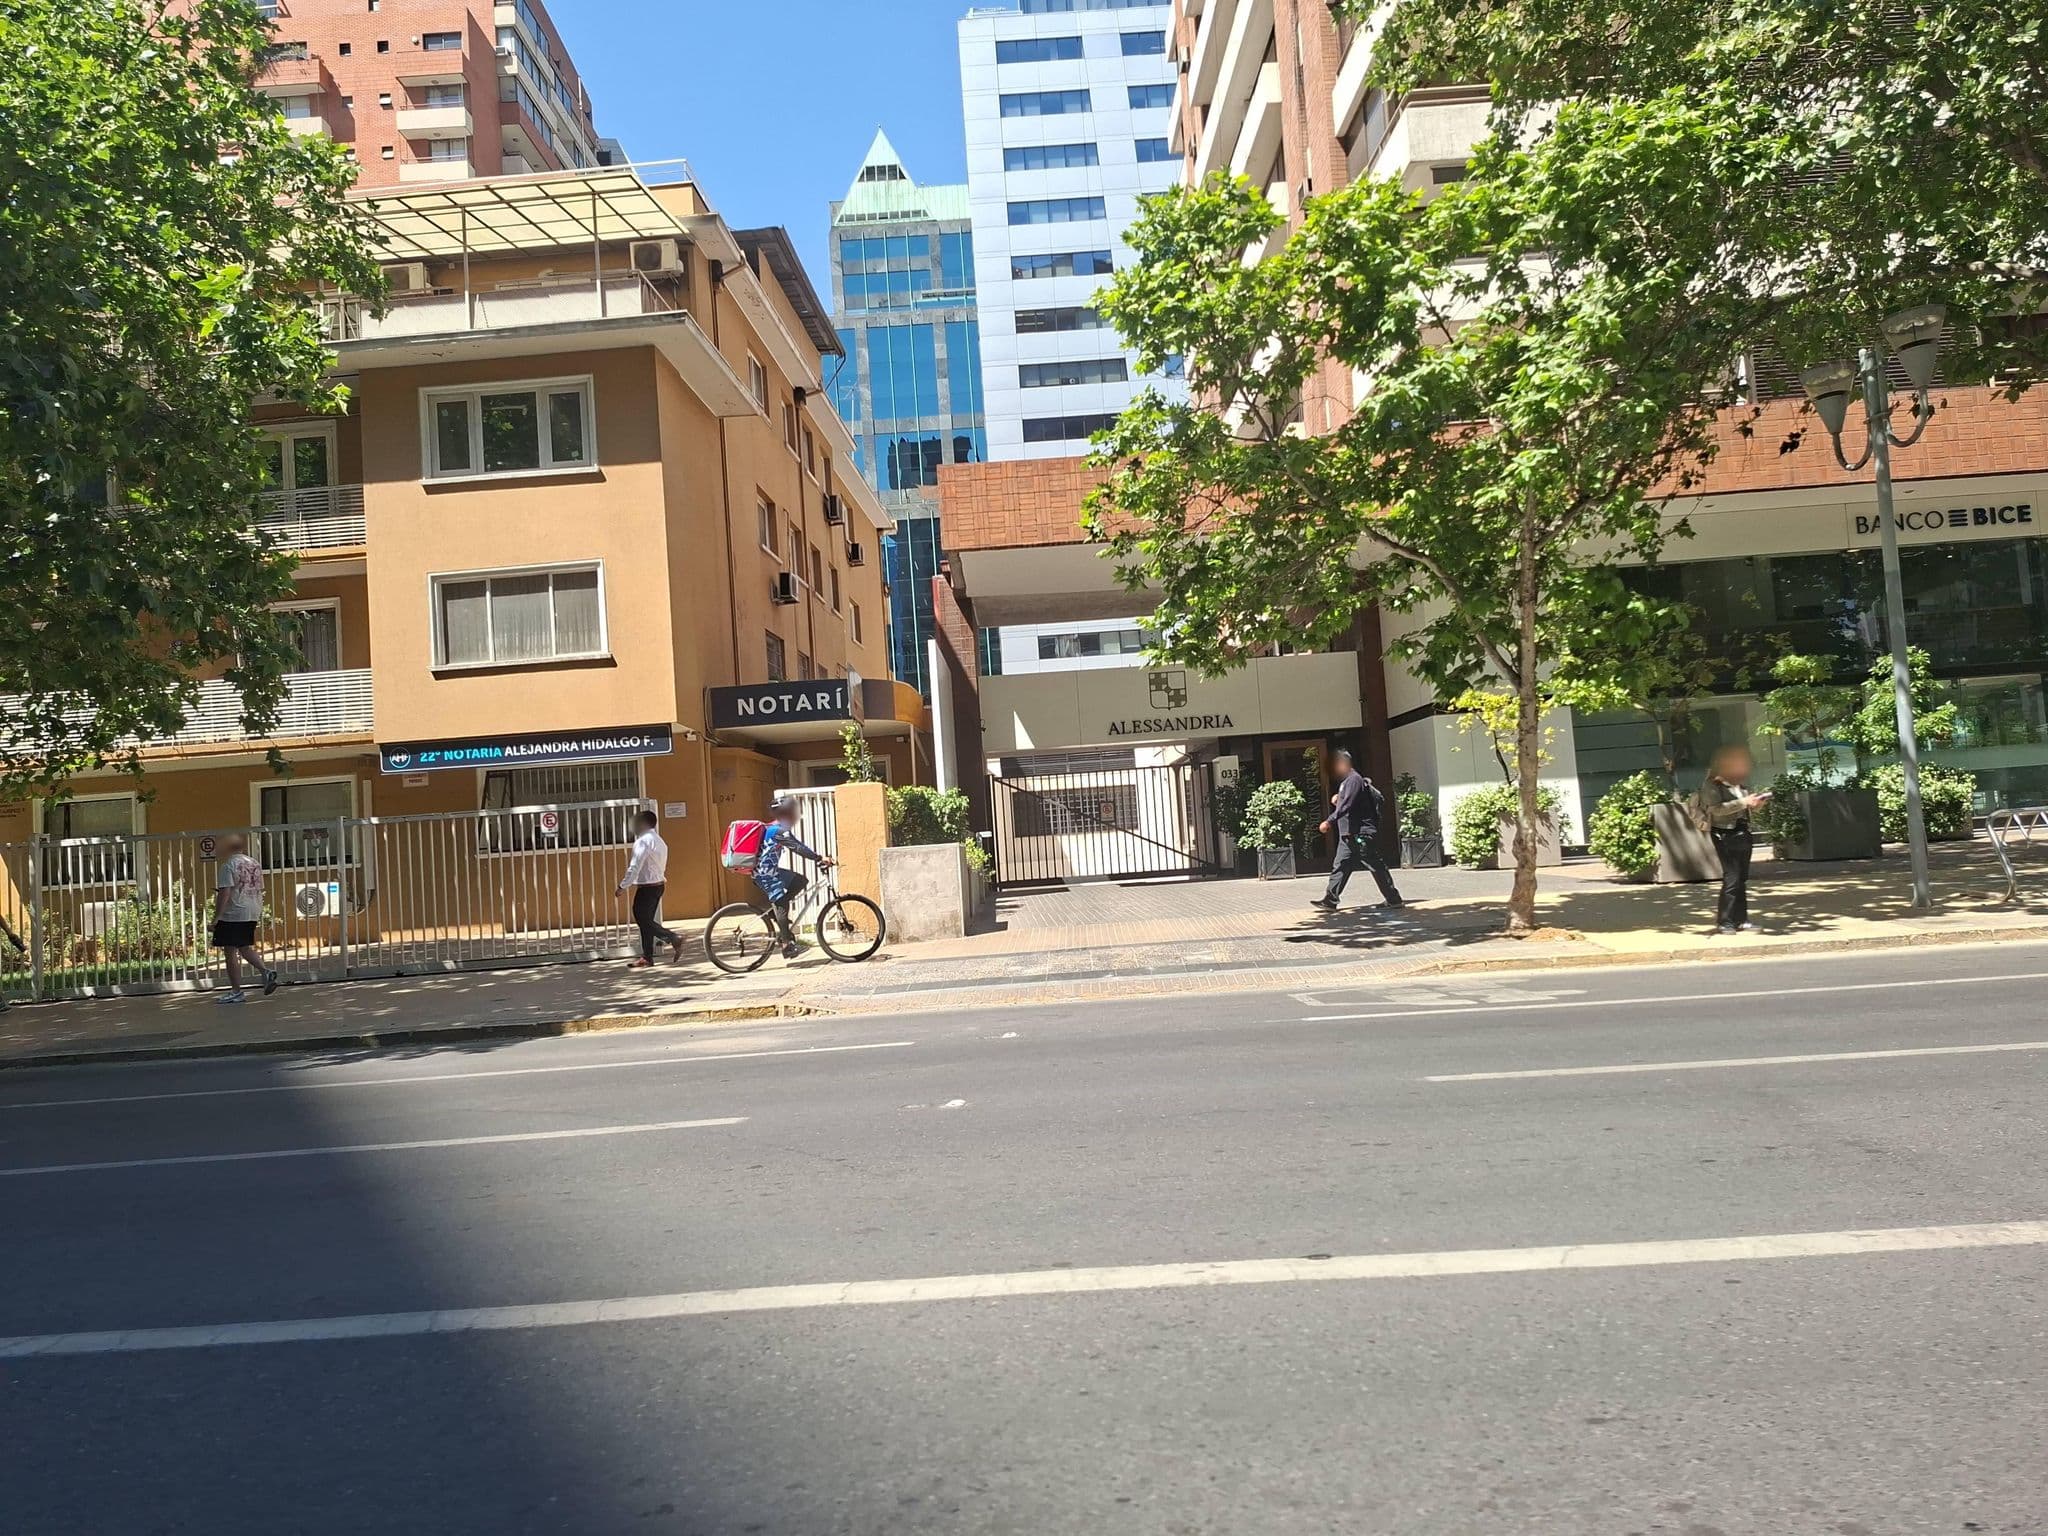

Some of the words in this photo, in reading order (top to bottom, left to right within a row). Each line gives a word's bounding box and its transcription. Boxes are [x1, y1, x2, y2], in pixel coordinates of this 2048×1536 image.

[1855, 510, 1945, 535] BANCO
[1973, 505, 2033, 526] BICE
[737, 688, 851, 716] NOTARÍ
[1108, 714, 1234, 736] ALESSANDRIA
[504, 740, 579, 757] ALEJANDRA
[581, 736, 641, 752] HIDALGO
[643, 735, 655, 747] F.
[1221, 768, 1238, 779] 033
